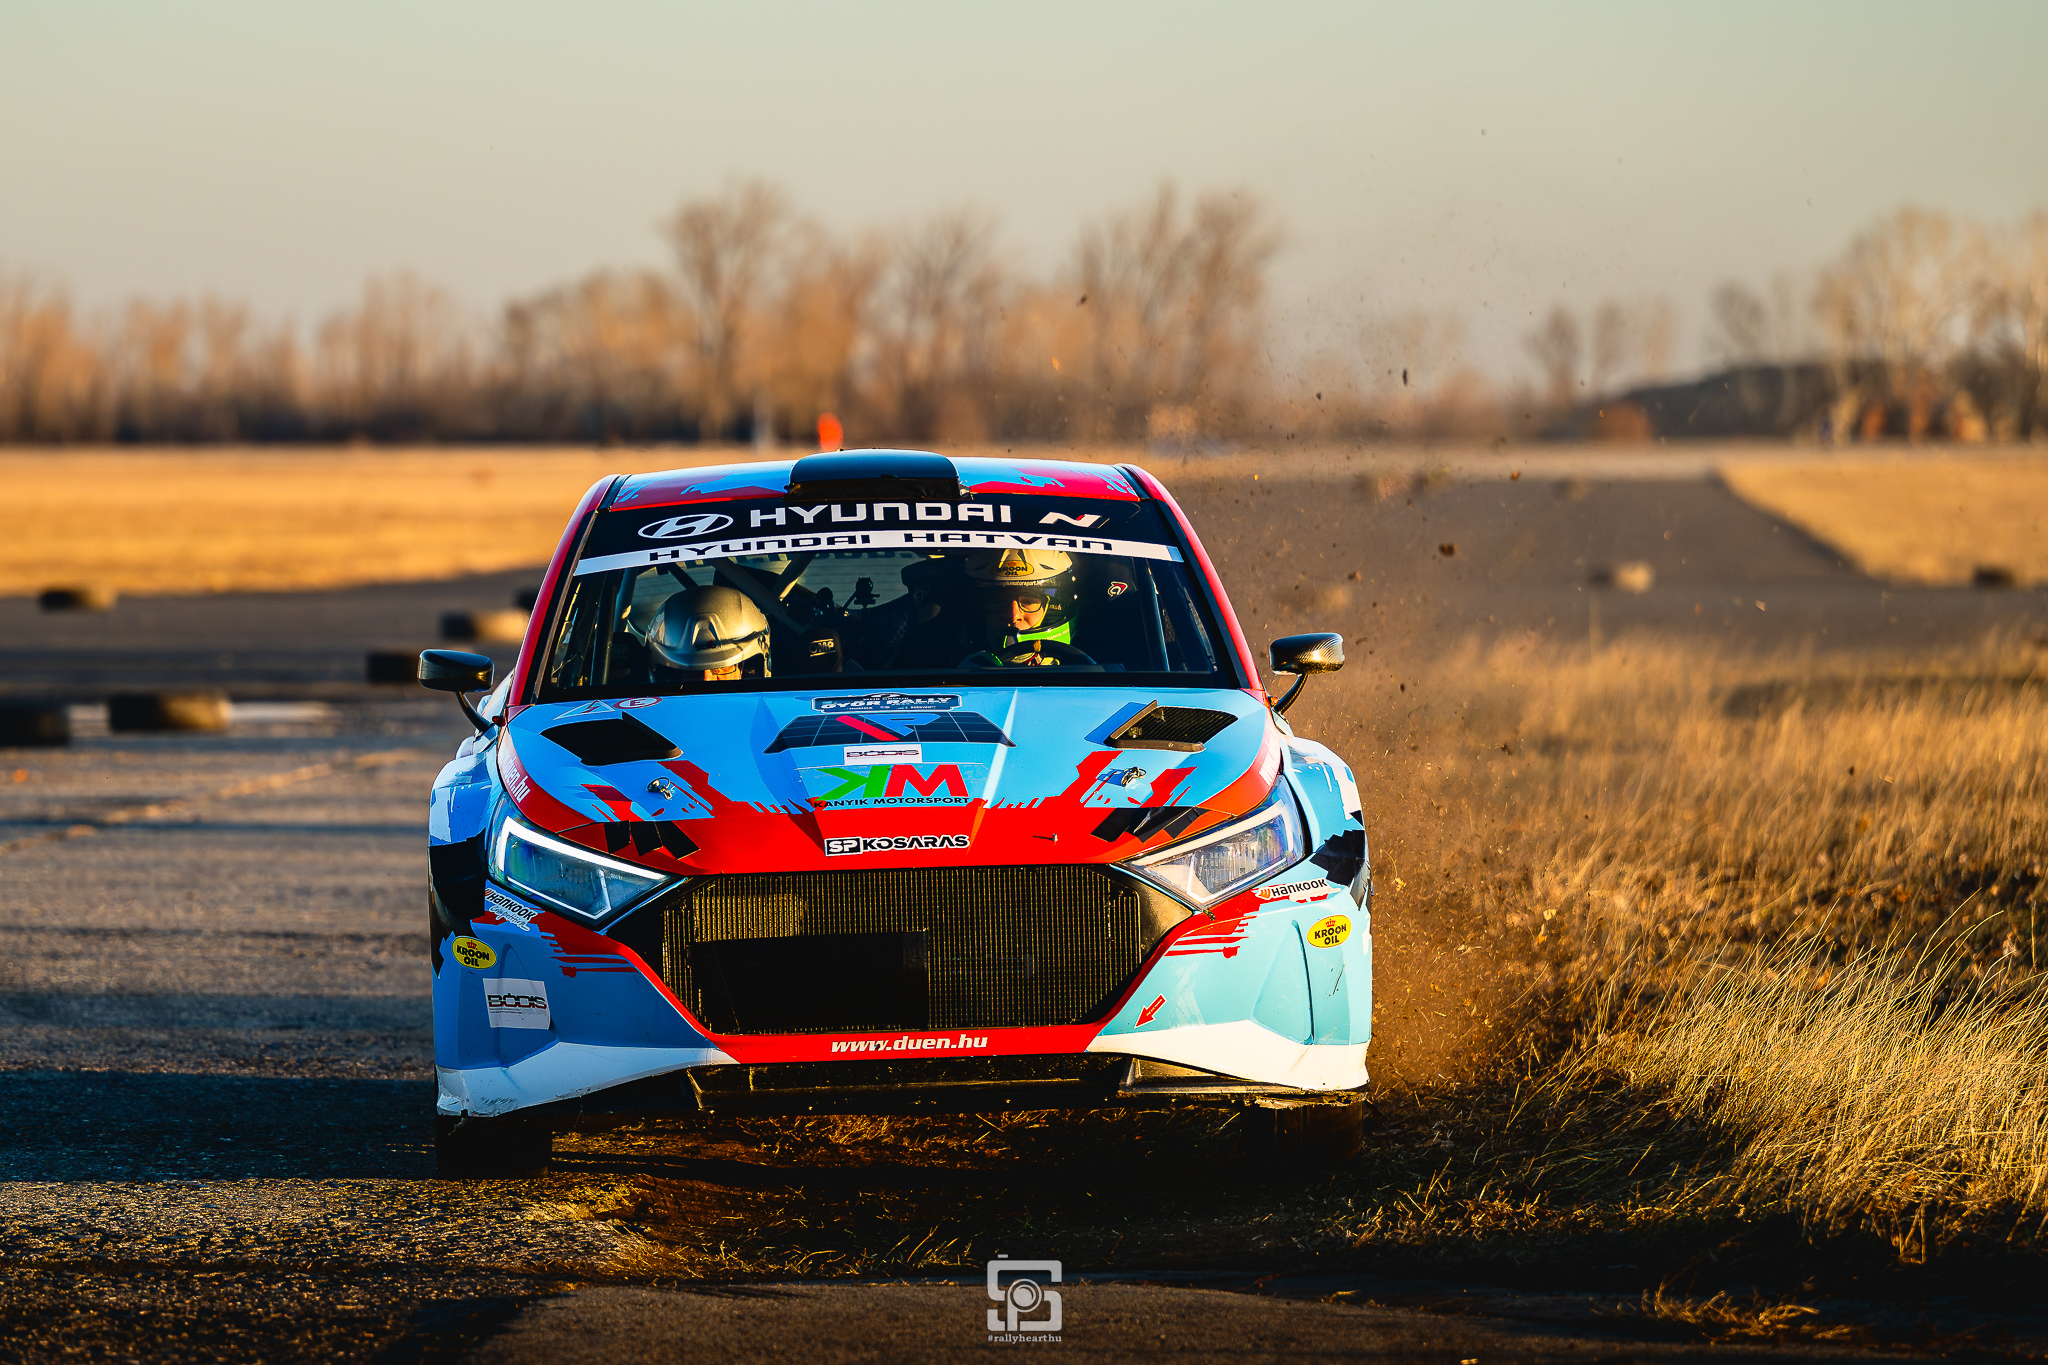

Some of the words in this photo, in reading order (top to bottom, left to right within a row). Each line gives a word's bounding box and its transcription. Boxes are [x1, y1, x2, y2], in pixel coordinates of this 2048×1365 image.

[750, 502, 1011, 529] HYUNDAI
[649, 534, 871, 563] HYUNDAI
[903, 531, 1114, 552] HATVAN
[999, 565, 1028, 573] ROON
[808, 639, 835, 654] OMP
[886, 697, 952, 706] RALLY
[813, 797, 869, 809] KANYIK
[873, 796, 970, 805] MOTORSPORT
[828, 839, 860, 854] SP
[862, 835, 970, 851] KOSARAS
[1314, 924, 1348, 940] KROON
[1323, 935, 1340, 946] OIL
[456, 944, 490, 961] KROON
[463, 956, 480, 968] OIL
[830, 1033, 989, 1053] www.duen.hu
